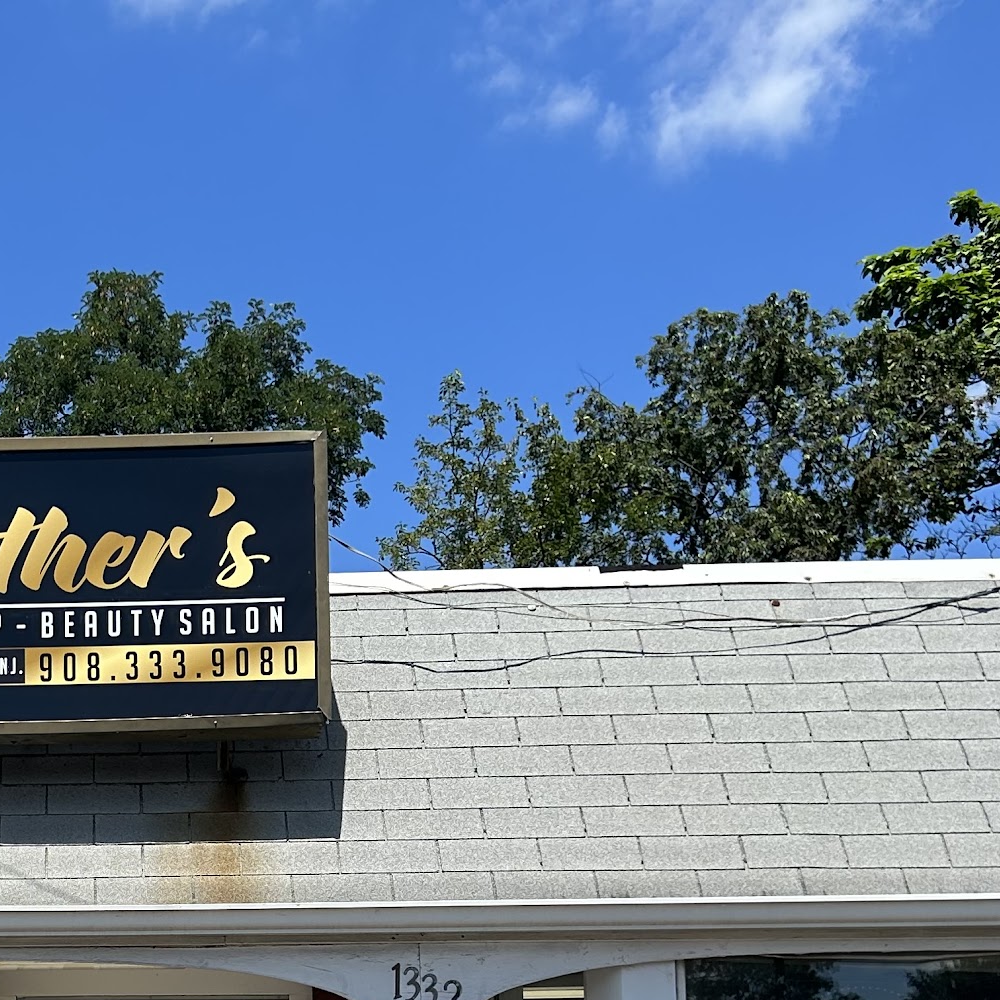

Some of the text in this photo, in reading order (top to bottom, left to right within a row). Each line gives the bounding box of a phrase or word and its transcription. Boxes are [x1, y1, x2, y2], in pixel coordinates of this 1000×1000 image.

[40, 608, 165, 639] BEAUTY
[179, 605, 283, 636] SALON
[39, 645, 298, 682] 908.333.9080
